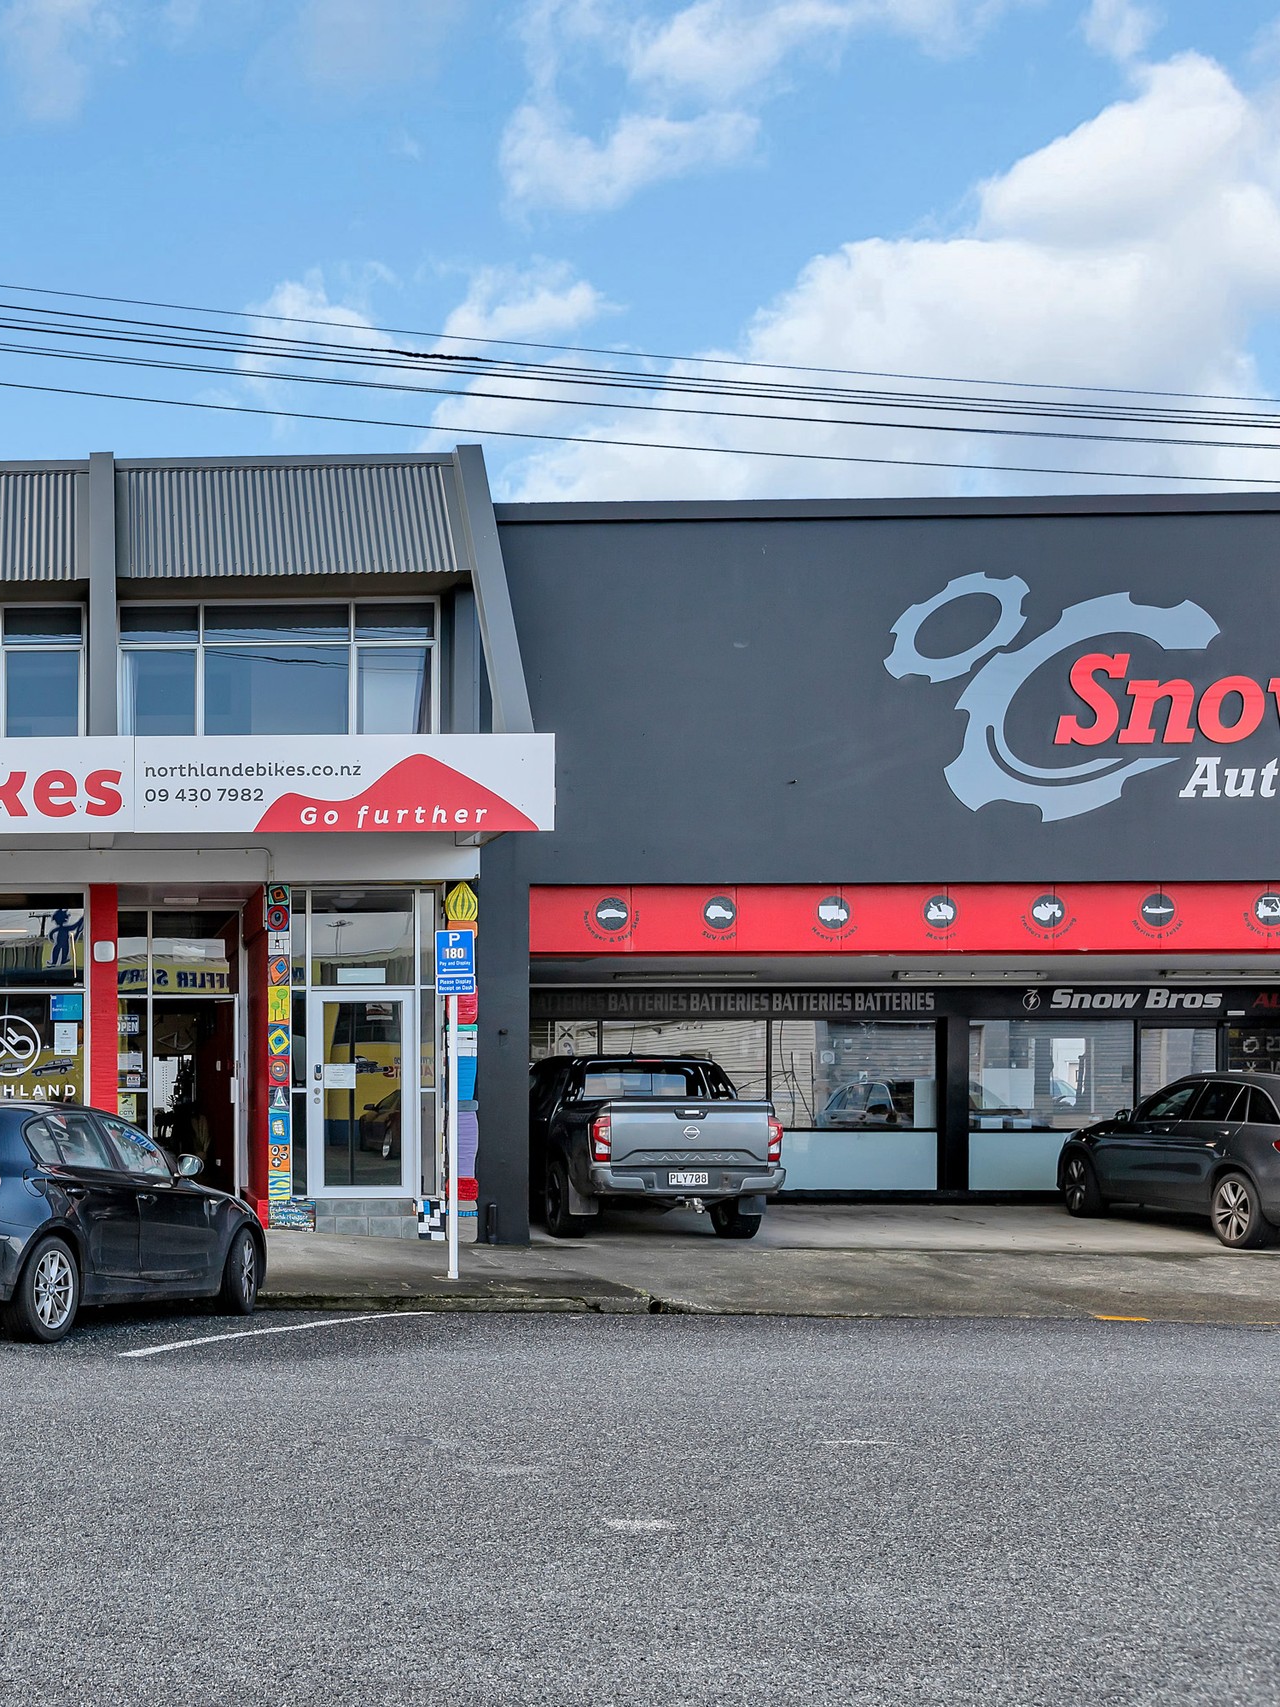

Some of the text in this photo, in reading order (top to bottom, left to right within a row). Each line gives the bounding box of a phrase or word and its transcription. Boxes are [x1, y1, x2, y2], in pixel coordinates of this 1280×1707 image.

[1053, 653, 1280, 746] Sno
[144, 761, 362, 778] northlandebikes.co.nz
[144, 787, 264, 802] 09 430 7982
[300, 804, 489, 828] Go further
[449, 933, 460, 946] P
[811, 926, 834, 942] Heavy
[926, 932, 957, 940] Mowers
[445, 948, 464, 959] 180
[608, 993, 687, 1012] BATTERIES
[690, 993, 769, 1012] BATTERIES
[772, 993, 852, 1012] BATTERIES
[855, 992, 935, 1011] BATTERIES
[1050, 988, 1141, 1010] Snow
[1144, 988, 1222, 1010] Bros
[640, 1153, 739, 1161] NAVARA
[670, 1174, 707, 1184] PLY708
